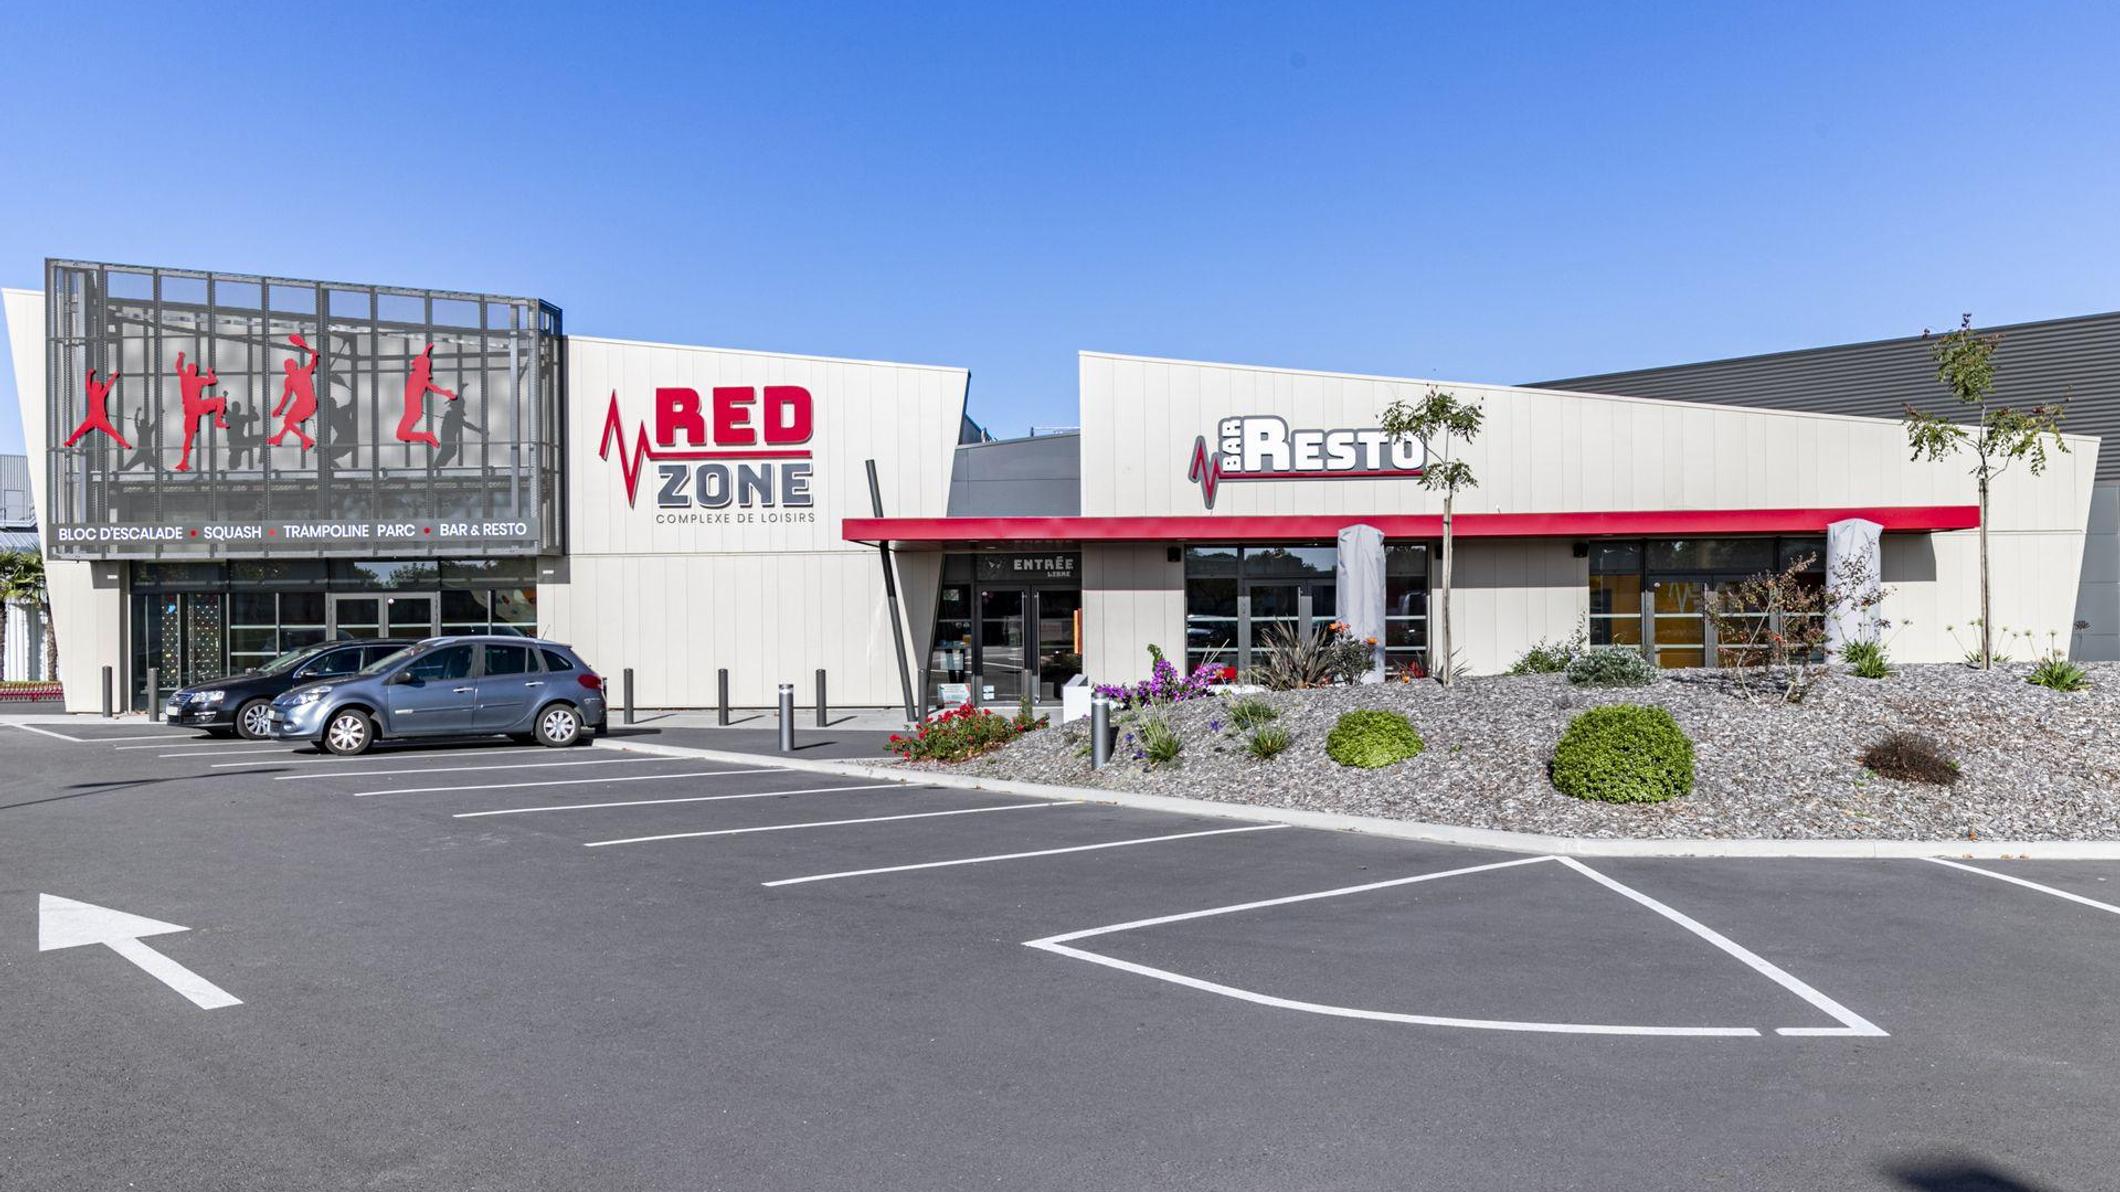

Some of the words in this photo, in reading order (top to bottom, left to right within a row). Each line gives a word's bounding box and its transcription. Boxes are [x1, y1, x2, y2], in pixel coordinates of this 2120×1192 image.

[655, 386, 815, 446] RED
[1221, 418, 1242, 473] BAR
[656, 462, 814, 509] ZONE
[656, 514, 730, 524] COMPLEXE
[737, 513, 754, 523] DE
[761, 512, 815, 523] LOISIRS
[58, 527, 97, 542] BLOC
[100, 525, 183, 541] D'ESCALADE
[203, 525, 262, 541] SQUASH
[283, 524, 370, 539] TRAMPOLINE
[377, 523, 416, 538] PARC
[439, 523, 467, 538] BAR
[470, 525, 480, 536] &
[483, 522, 527, 537] RESTO
[1013, 555, 1074, 571] ENTRÉE
